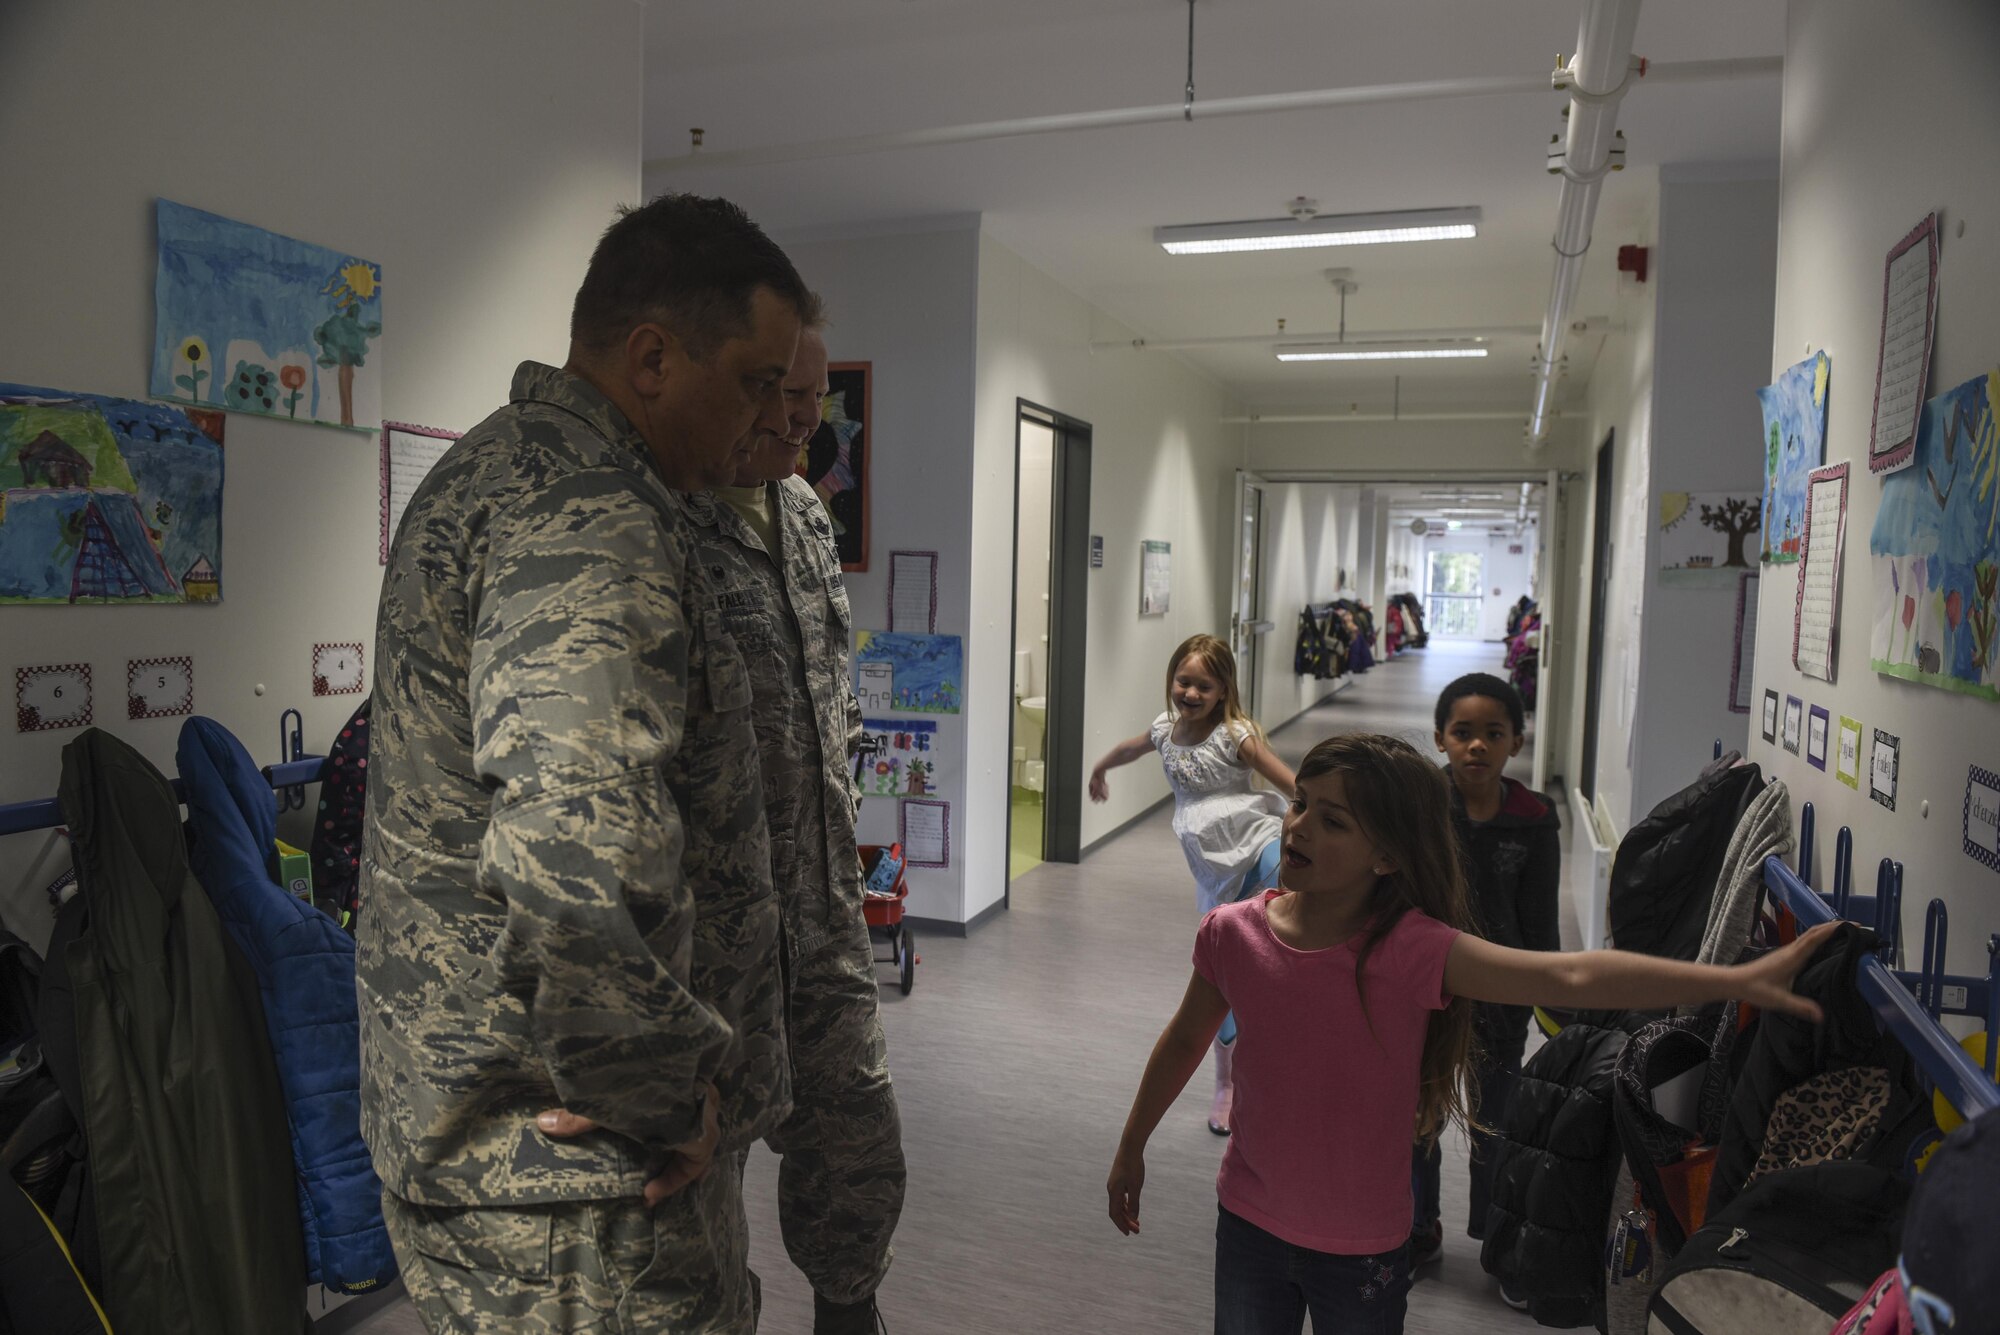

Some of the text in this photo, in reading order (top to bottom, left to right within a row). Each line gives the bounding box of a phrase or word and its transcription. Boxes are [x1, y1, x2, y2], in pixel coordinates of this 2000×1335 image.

[337, 660, 345, 671] 4
[157, 676, 165, 688] 5
[53, 685, 63, 699] 6
